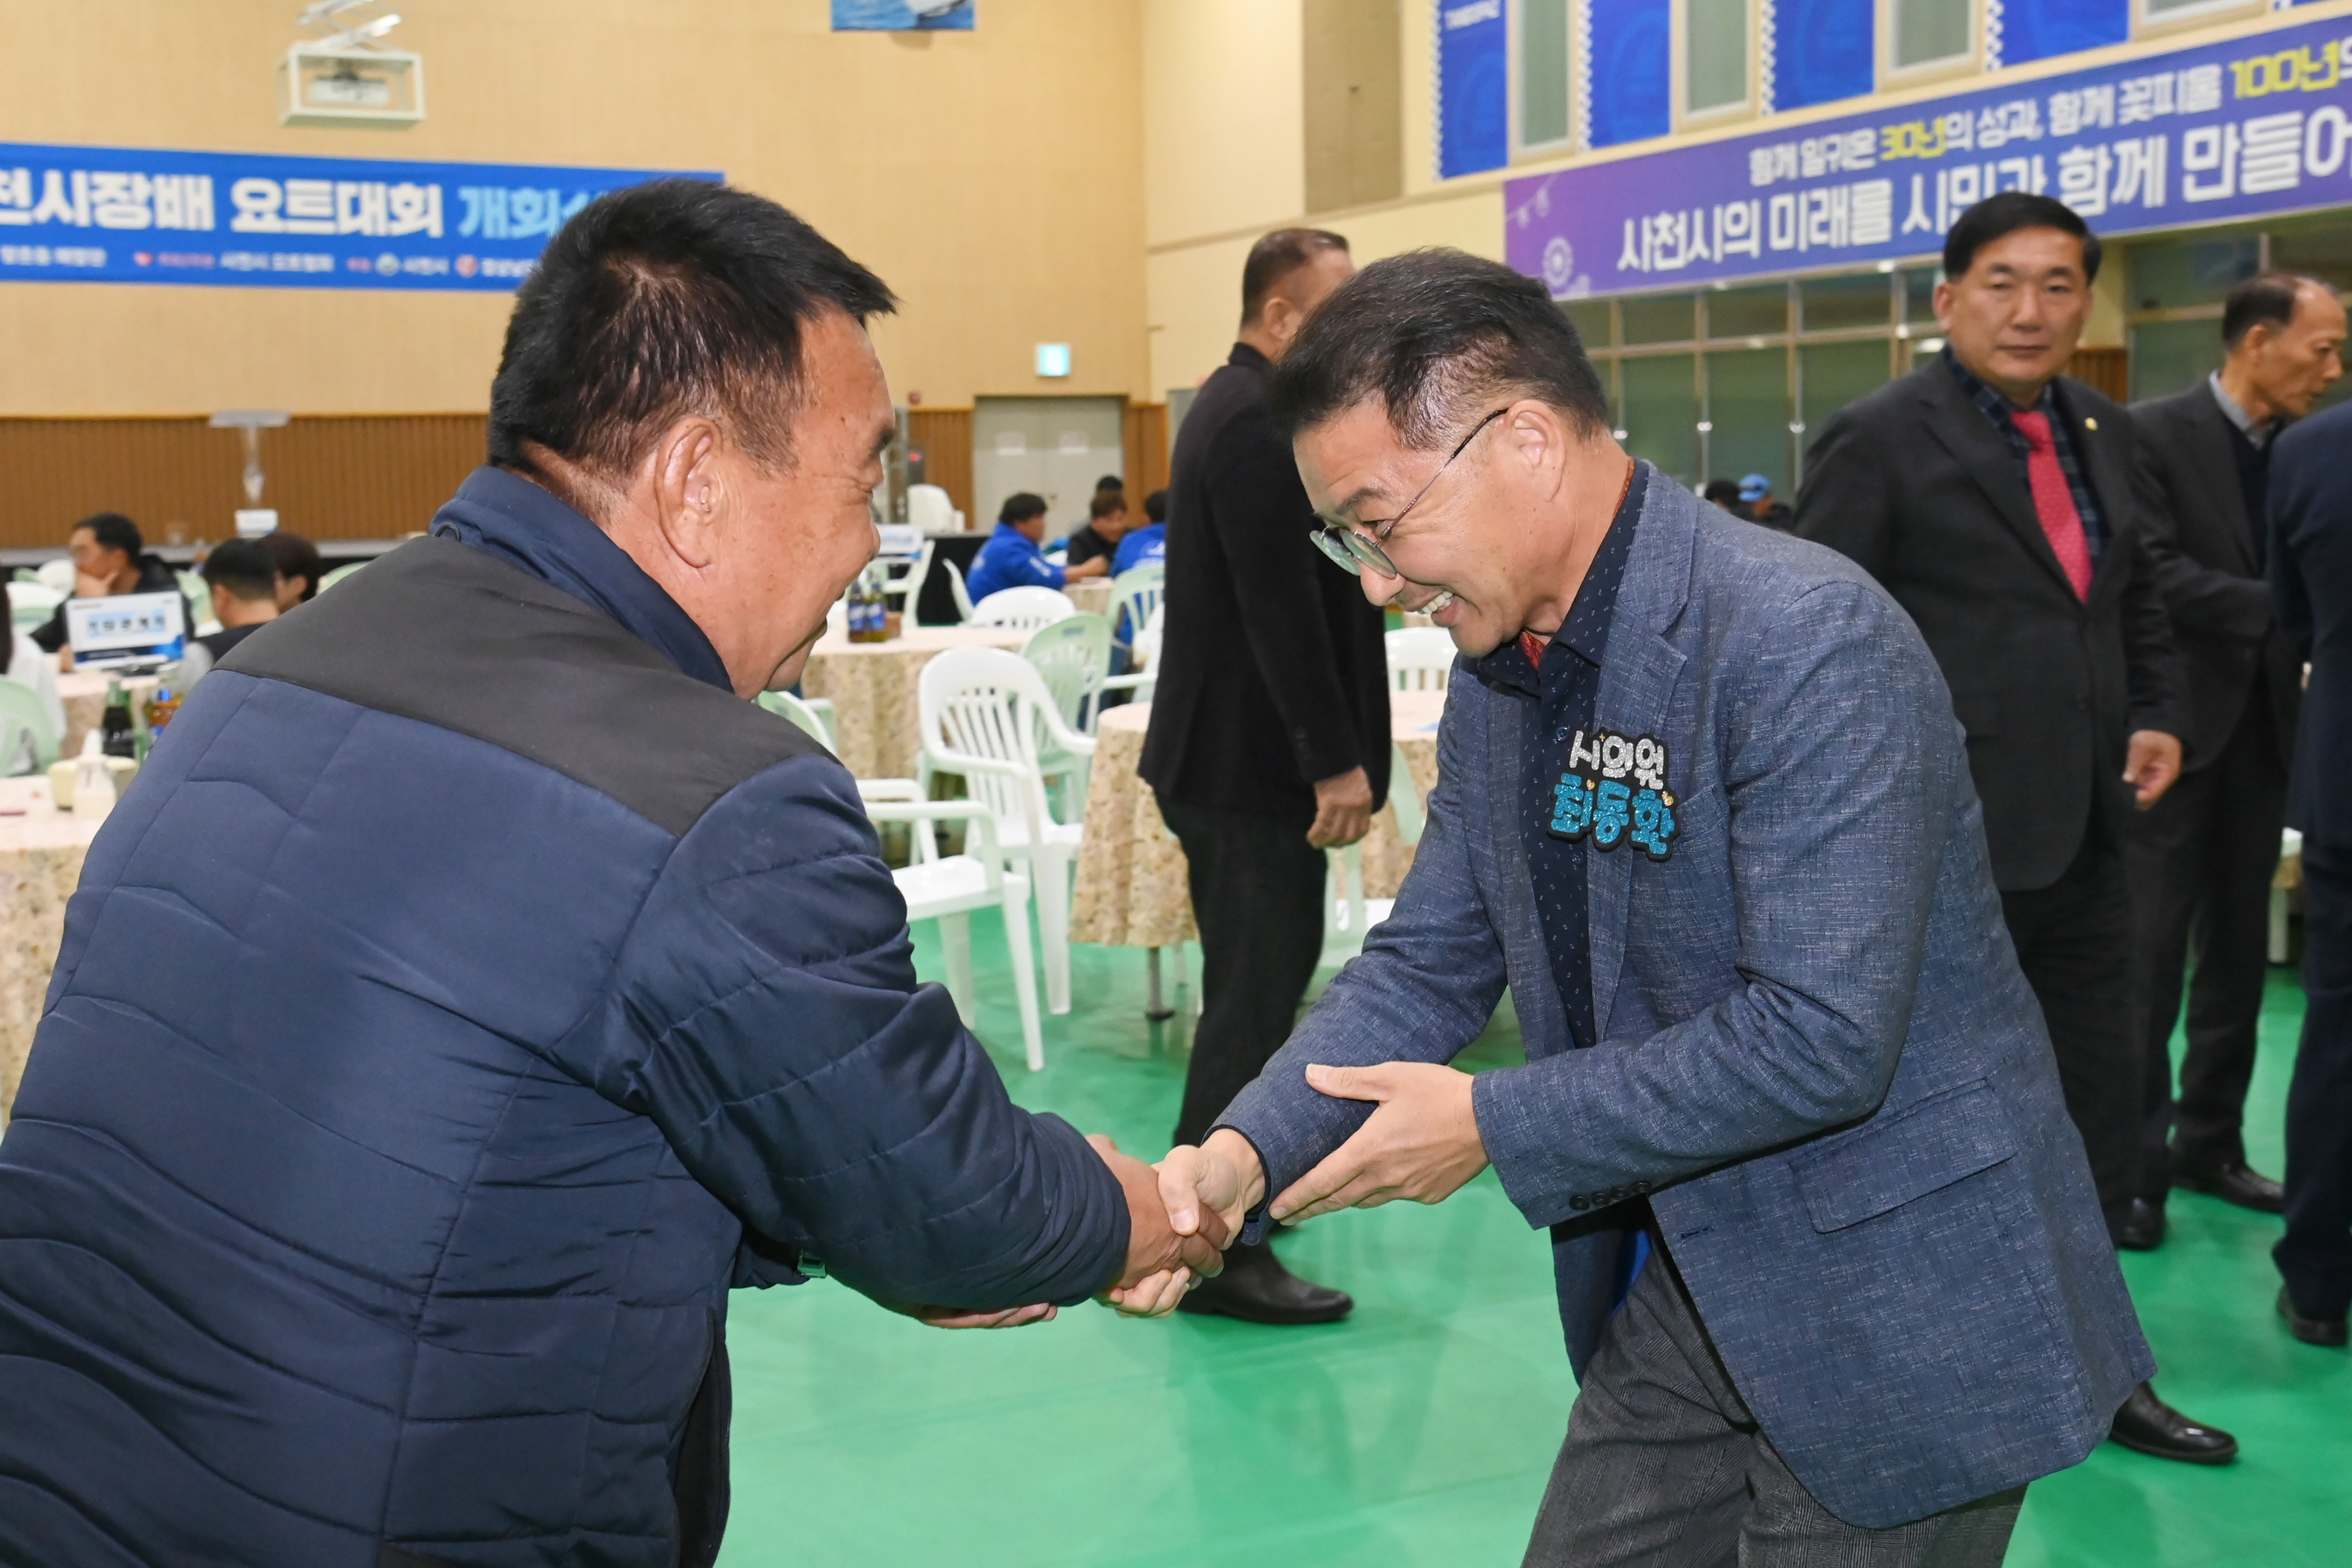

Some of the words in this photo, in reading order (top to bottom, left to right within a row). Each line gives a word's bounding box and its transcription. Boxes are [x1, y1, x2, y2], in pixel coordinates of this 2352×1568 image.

[1881, 110, 1974, 161] 30년의
[2049, 84, 2115, 136] 함께
[230, 177, 444, 238] 요트대회
[457, 185, 609, 239] 개회
[1616, 198, 1761, 273] 사천시의
[1769, 177, 1893, 252] 미래를
[2057, 134, 2167, 217] 함께
[1569, 730, 1664, 790] 시의원
[1551, 773, 1675, 854] 최동환
